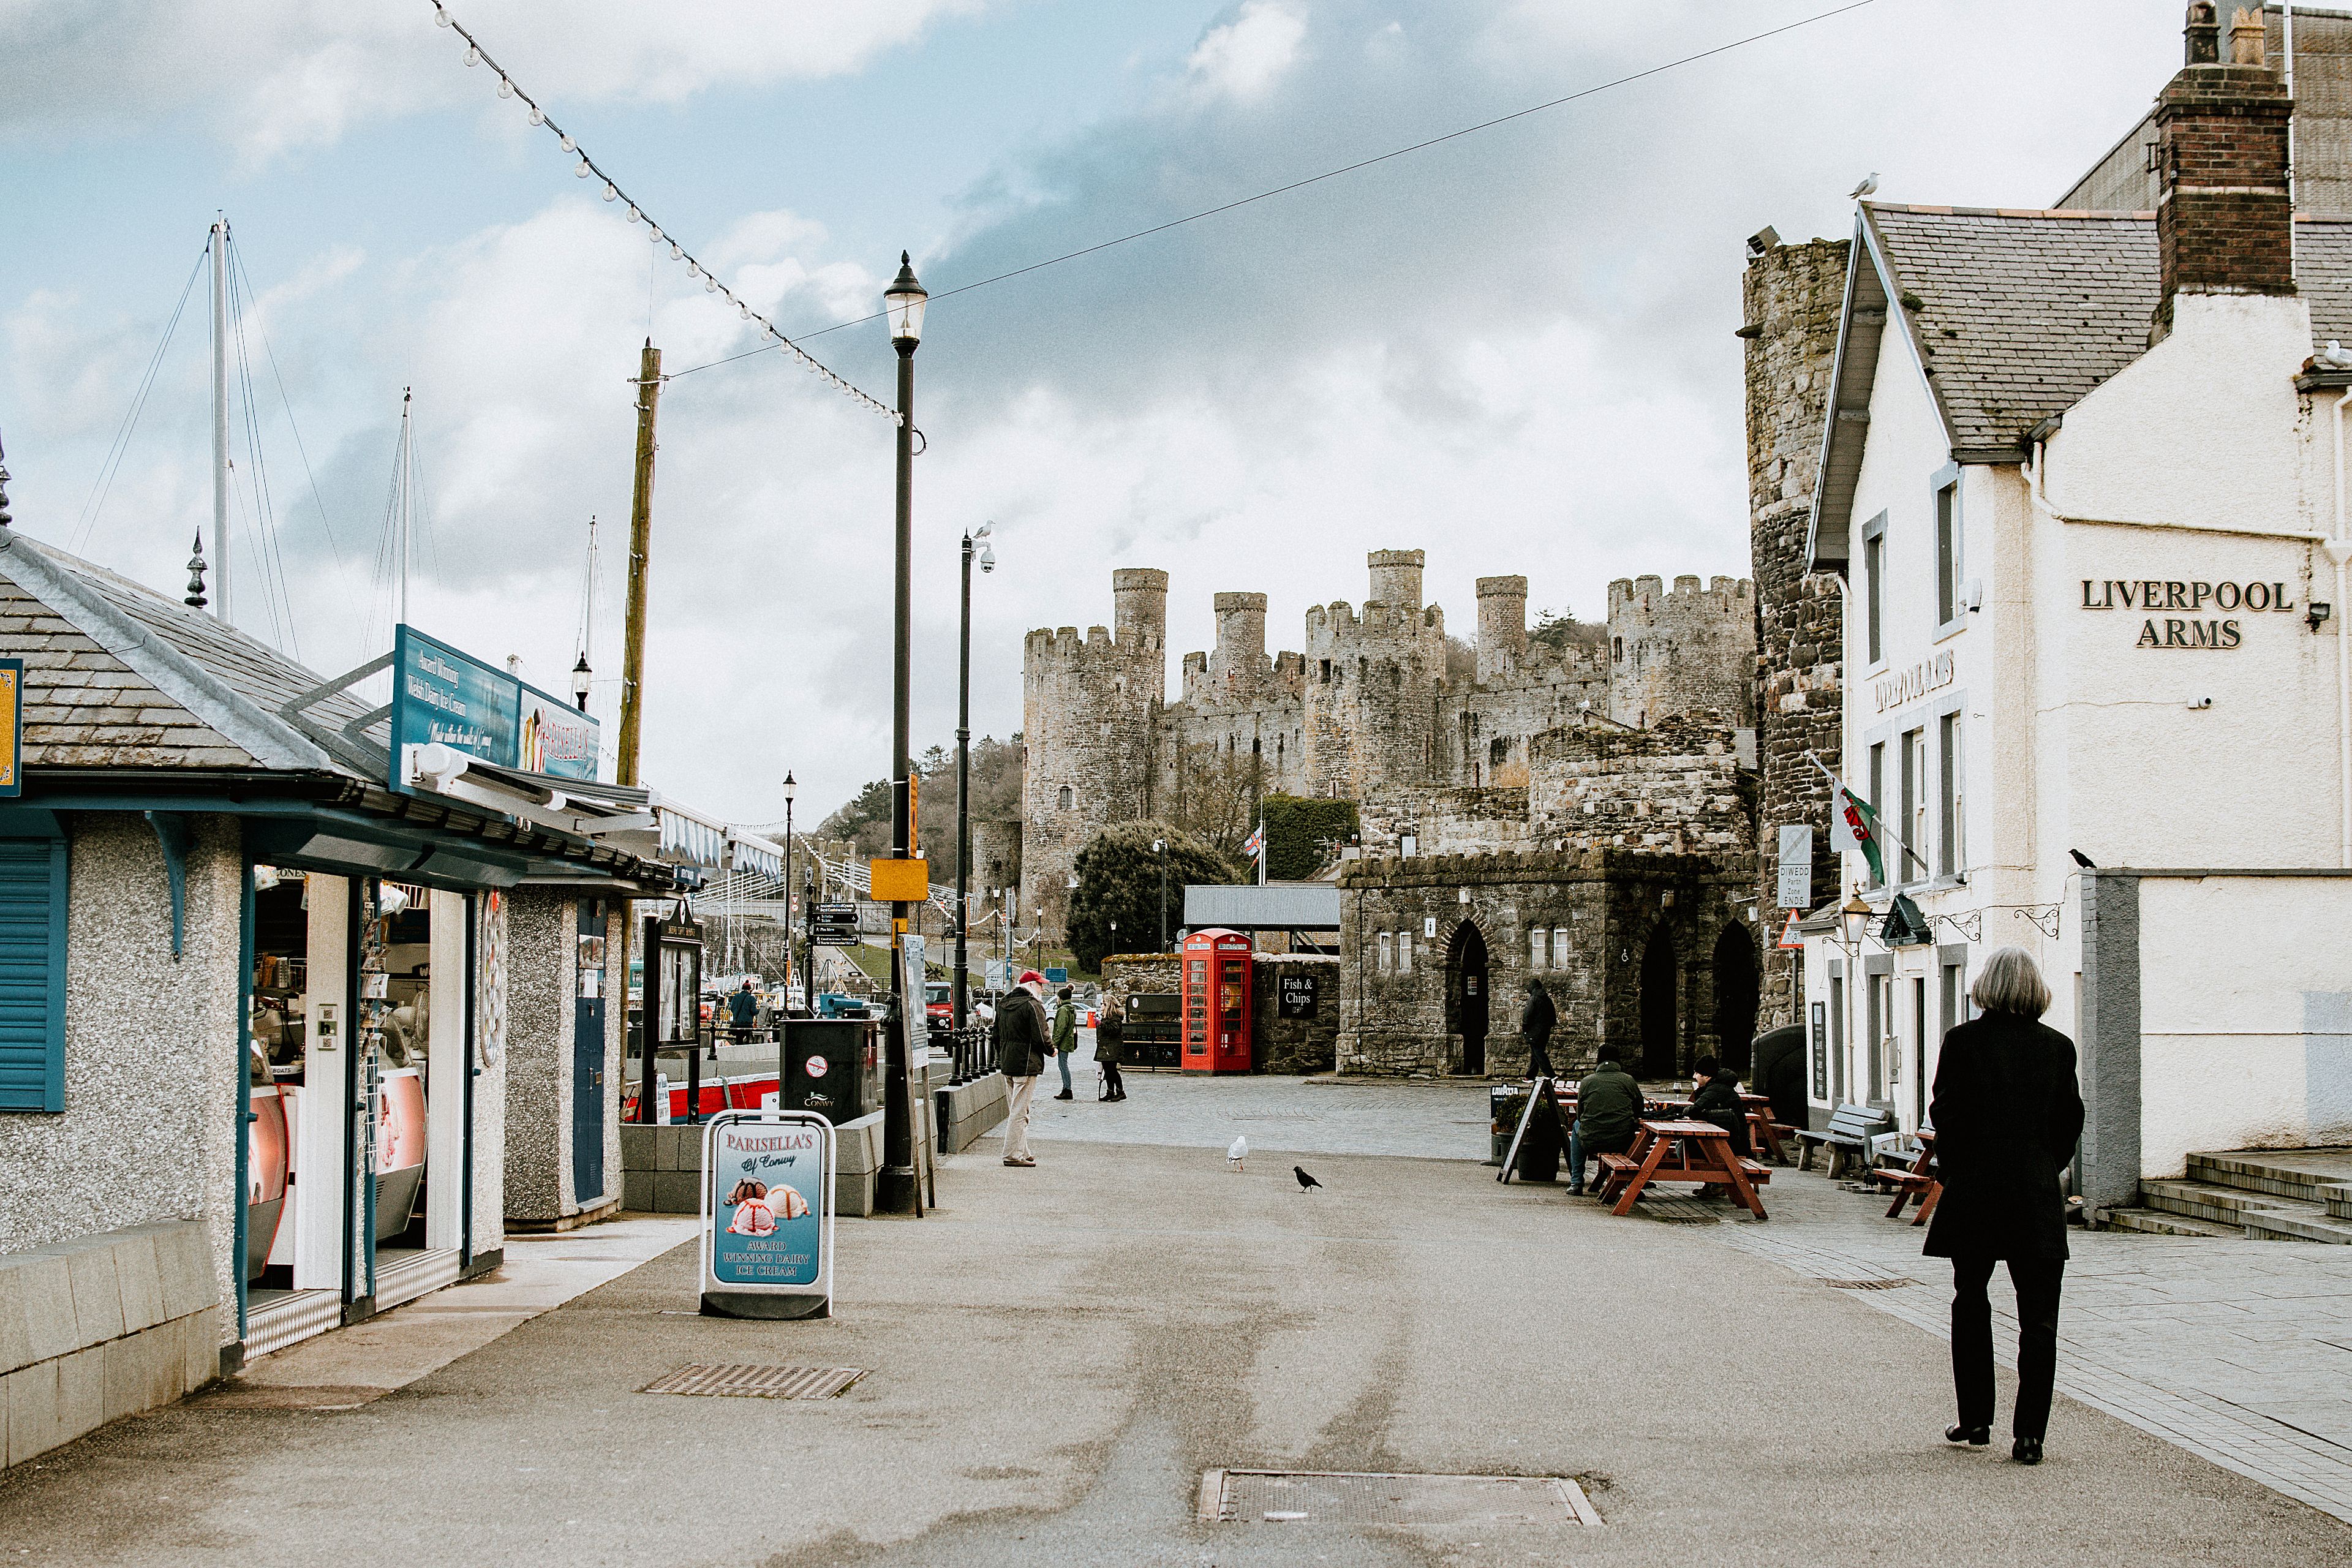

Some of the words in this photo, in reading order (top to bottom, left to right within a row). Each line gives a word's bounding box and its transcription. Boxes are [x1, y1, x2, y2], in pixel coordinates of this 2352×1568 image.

[2081, 579, 2294, 612] LIVERPOOL
[2136, 618, 2242, 649] ARMS
[418, 648, 437, 676] Award
[437, 656, 459, 690] Winning
[1875, 662, 1924, 714] LIVERPOOL
[1924, 647, 1954, 692] ARMS
[407, 674, 424, 701] Welsh
[425, 681, 440, 710] Dairy
[450, 692, 466, 717] Cream
[539, 705, 589, 762] PARISELLA'S
[277, 868, 306, 877] ONES
[1781, 867, 1809, 876] DIWEDD
[1284, 978, 1302, 989] Fish
[1305, 979, 1313, 989] &
[1286, 992, 1310, 1006] Chips
[1491, 1084, 1518, 1096] LAVAZZA
[726, 1133, 813, 1153] PARISELLA'S
[741, 1156, 758, 1175] Of
[759, 1154, 797, 1167] Conwy
[747, 1240, 787, 1251] AWARD
[723, 1253, 773, 1263] WINNING
[775, 1254, 810, 1265] DAIRY
[736, 1265, 754, 1275] ICE
[757, 1265, 797, 1276] CREAM
